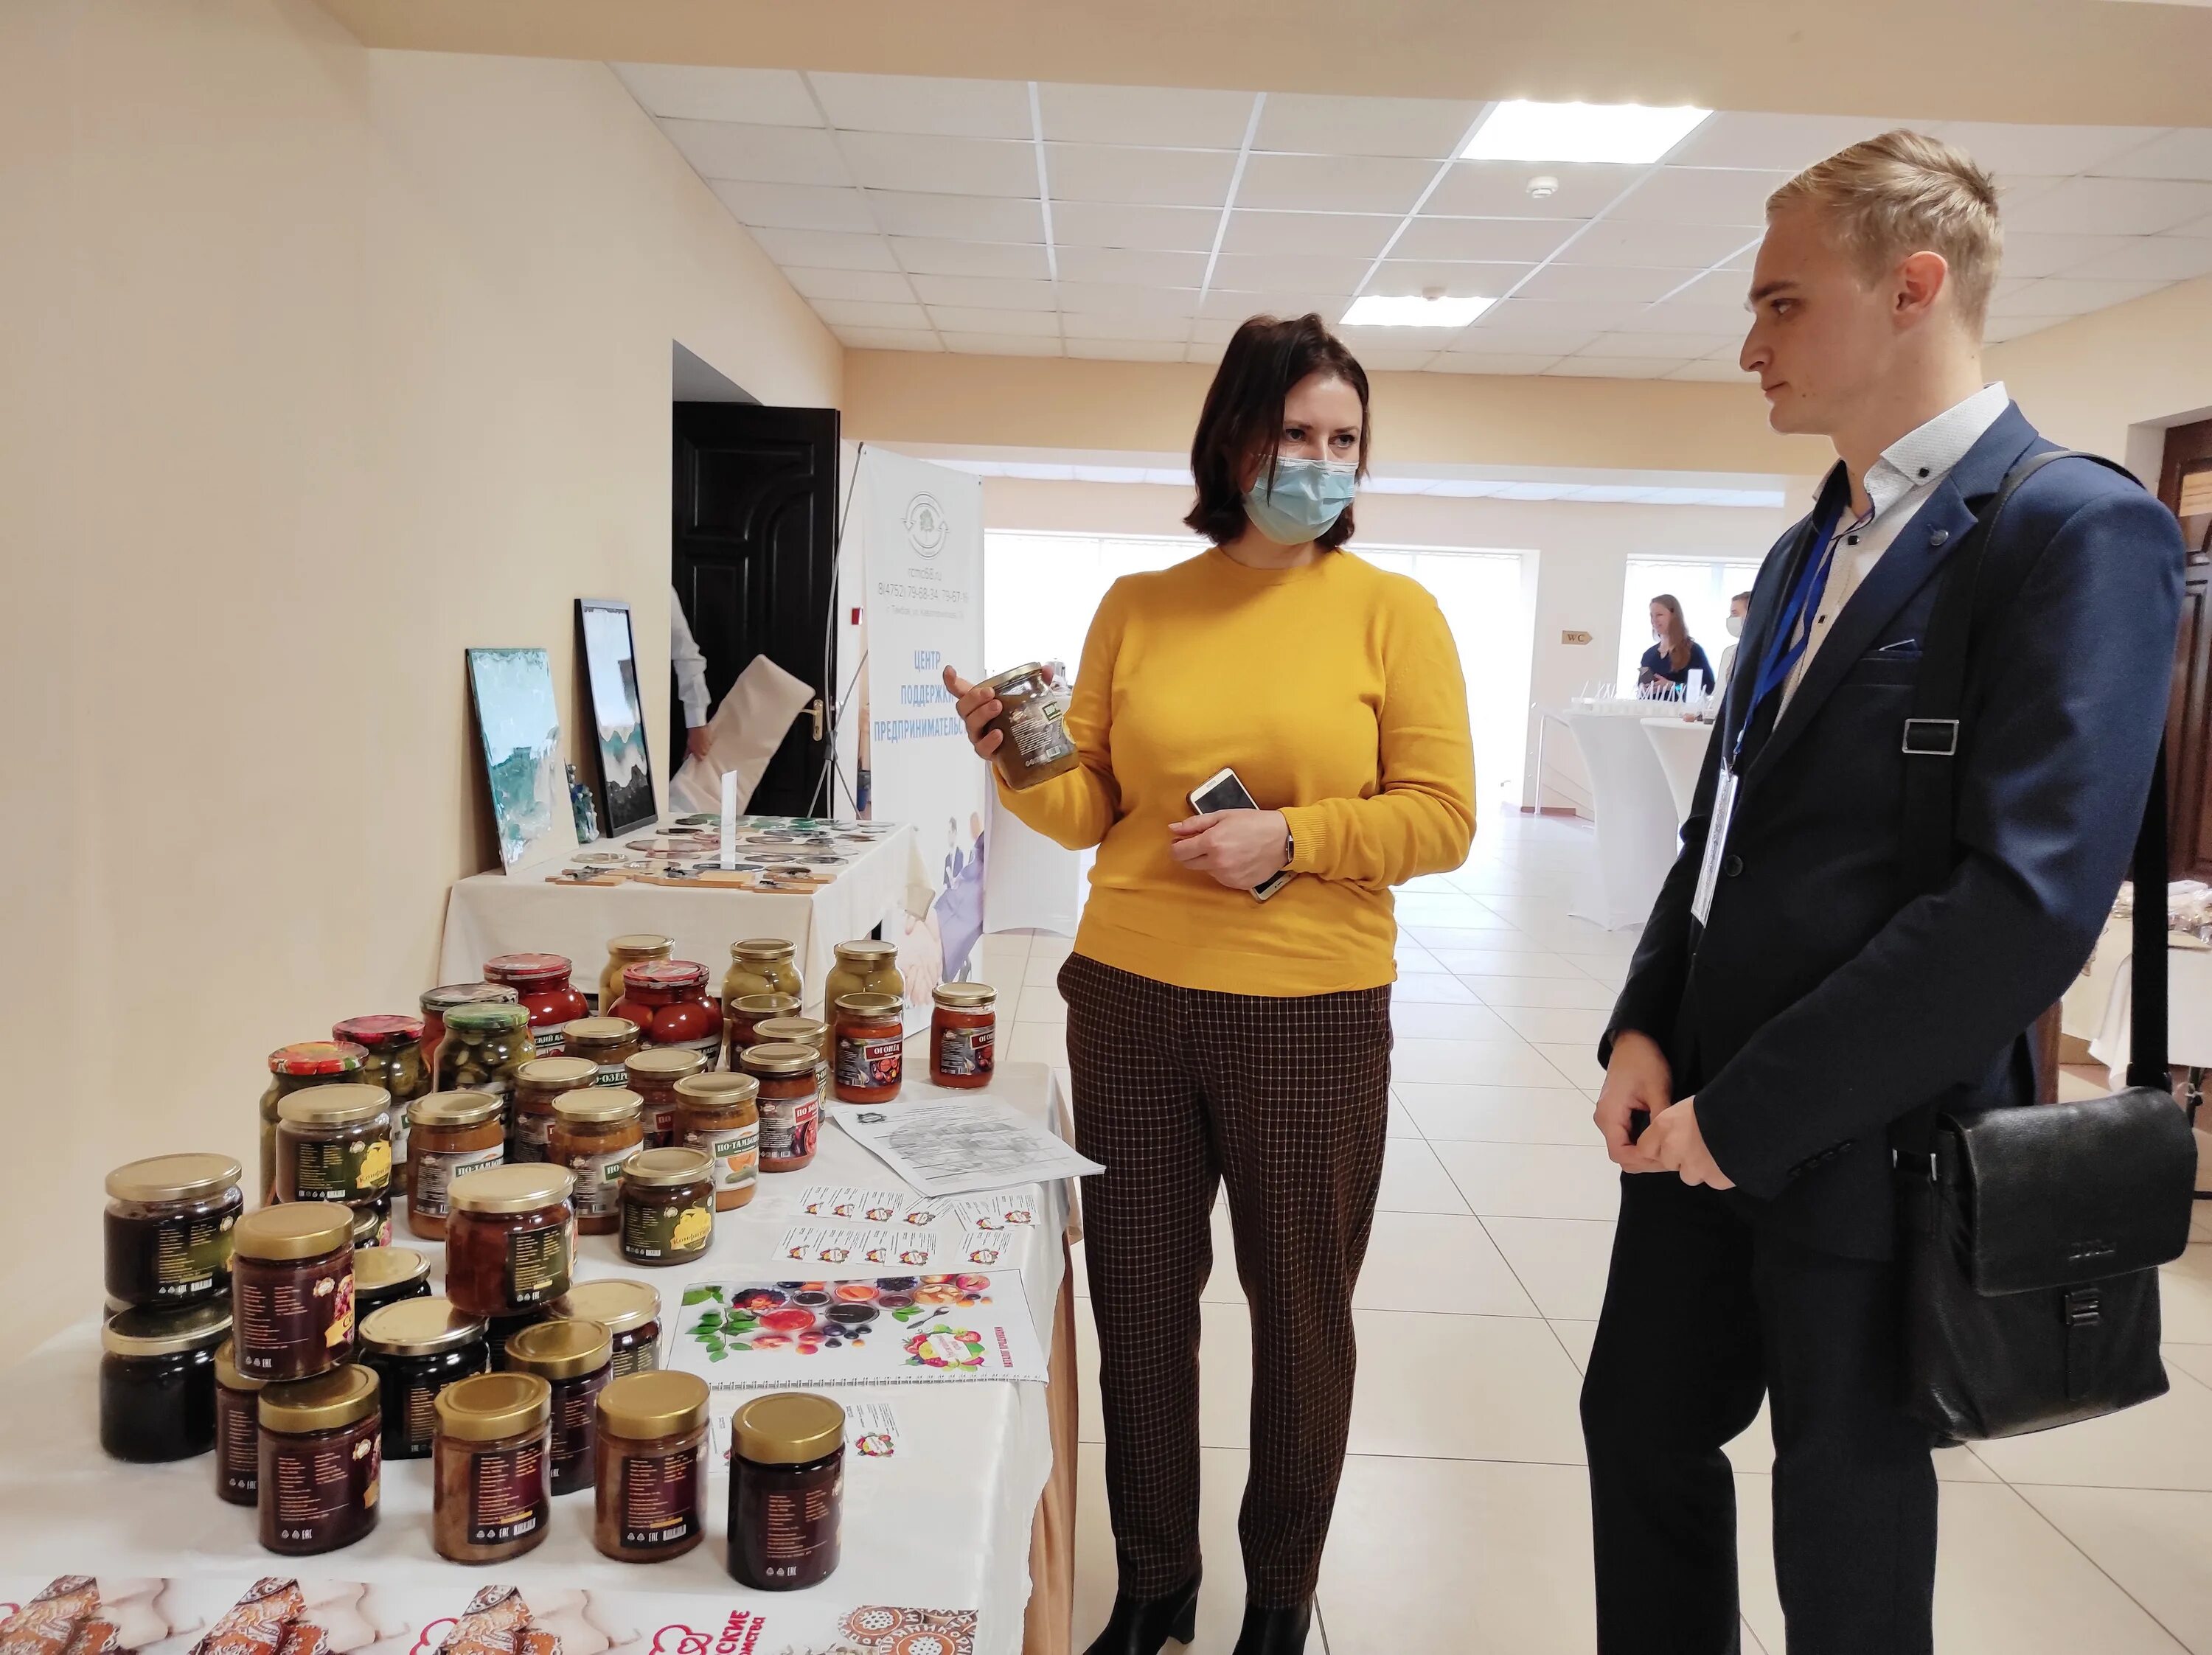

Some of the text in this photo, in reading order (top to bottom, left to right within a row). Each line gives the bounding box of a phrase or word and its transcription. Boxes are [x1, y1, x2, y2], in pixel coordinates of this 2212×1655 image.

[1568, 634, 1585, 642] WC
[914, 650, 941, 672] ЦЕНТР
[874, 717, 967, 744] ПРЕДПРИНИМАТЕЛЬС
